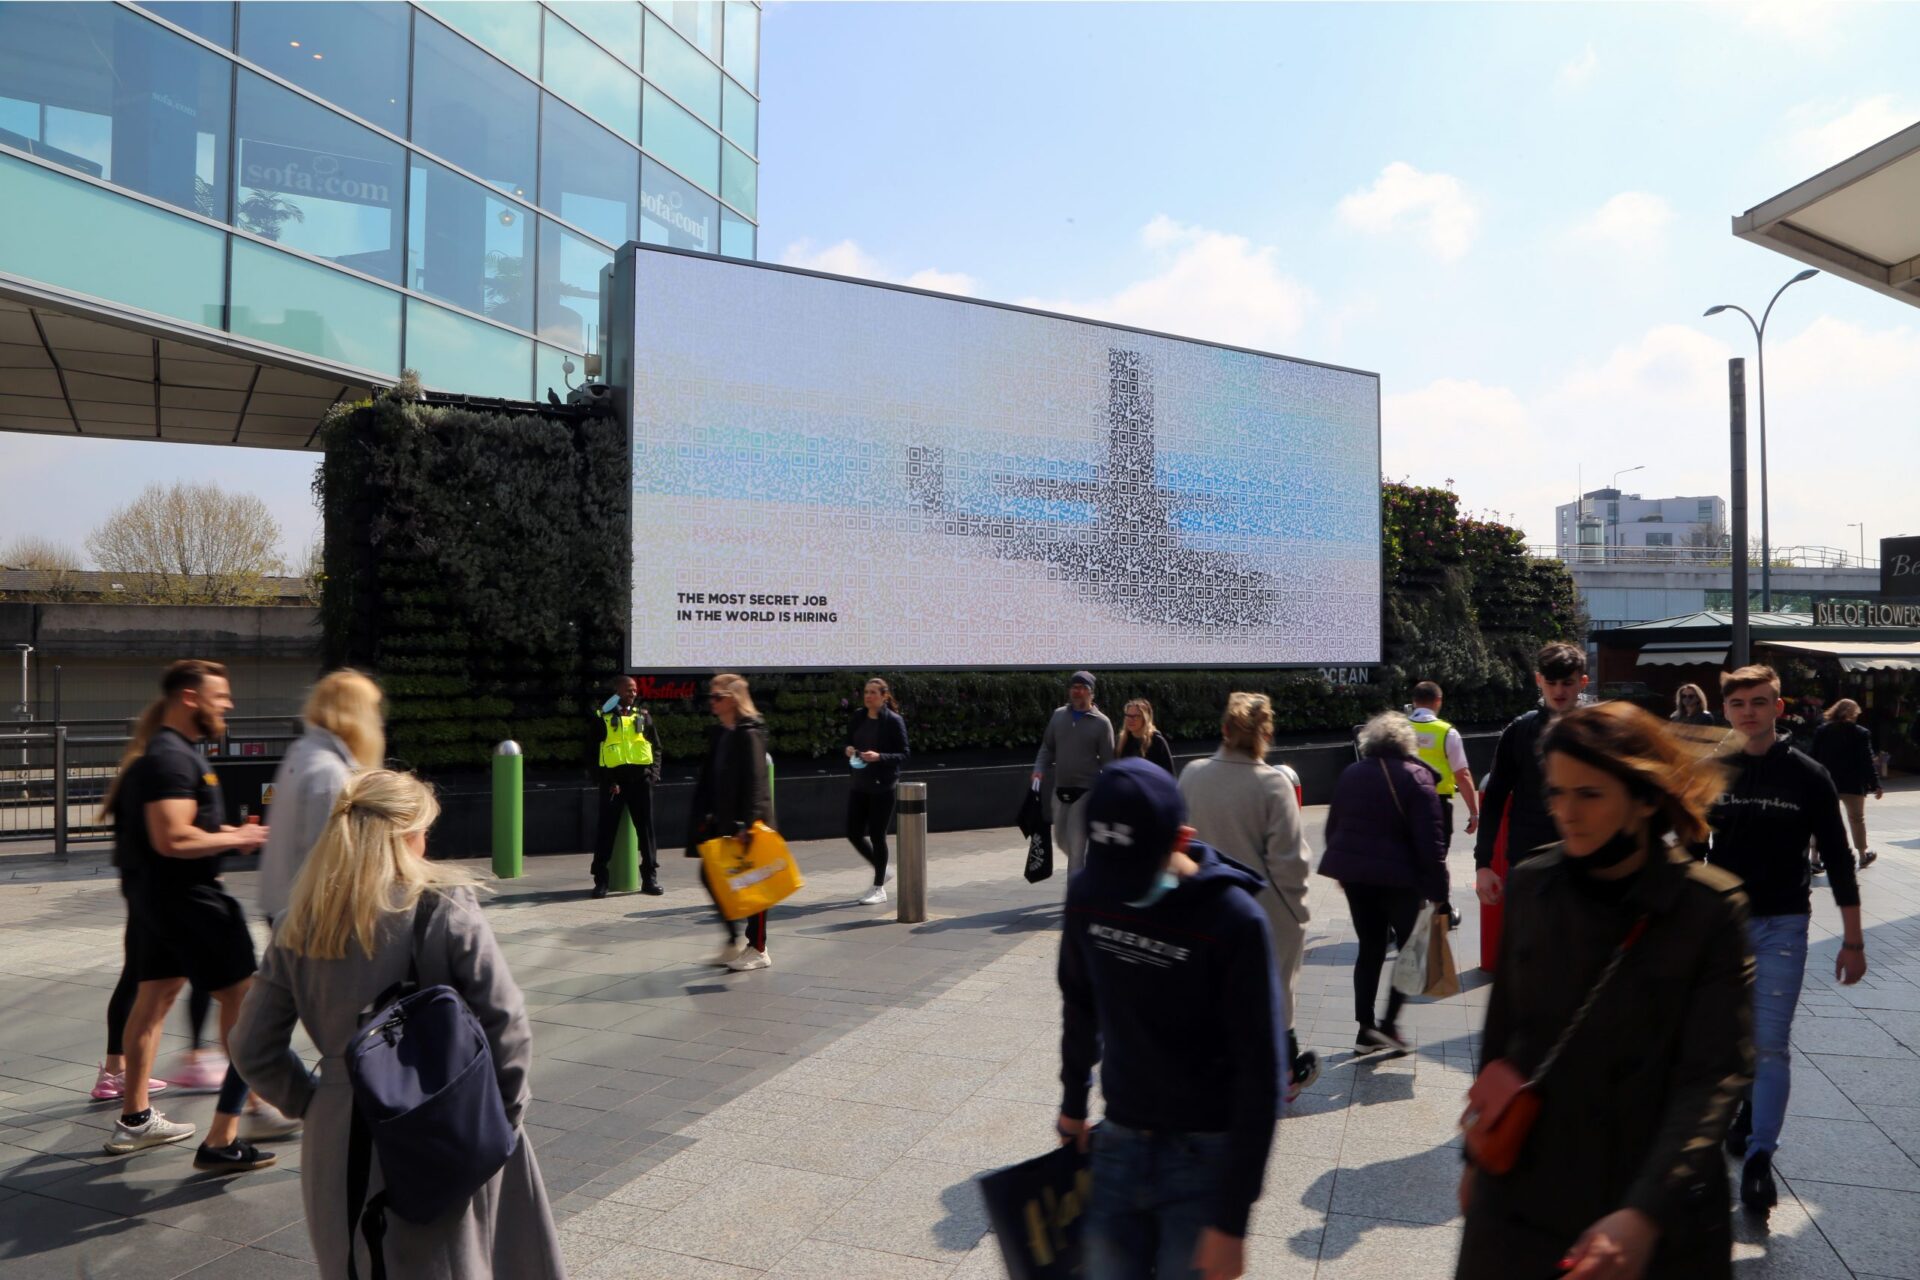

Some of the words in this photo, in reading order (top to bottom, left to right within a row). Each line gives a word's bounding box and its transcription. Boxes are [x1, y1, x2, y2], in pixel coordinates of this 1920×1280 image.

[247, 162, 389, 201] sofa.com
[677, 593, 704, 604] THE
[708, 594, 746, 605] MOST
[749, 595, 799, 606] SECRET
[802, 596, 828, 606] JOB
[677, 610, 692, 621] IN
[695, 610, 722, 621] THE
[725, 611, 775, 622] WORLD
[779, 612, 791, 622] IS
[794, 612, 838, 623] HIRING
[1818, 603, 1840, 624] ISLE
[1844, 604, 1864, 625] OF
